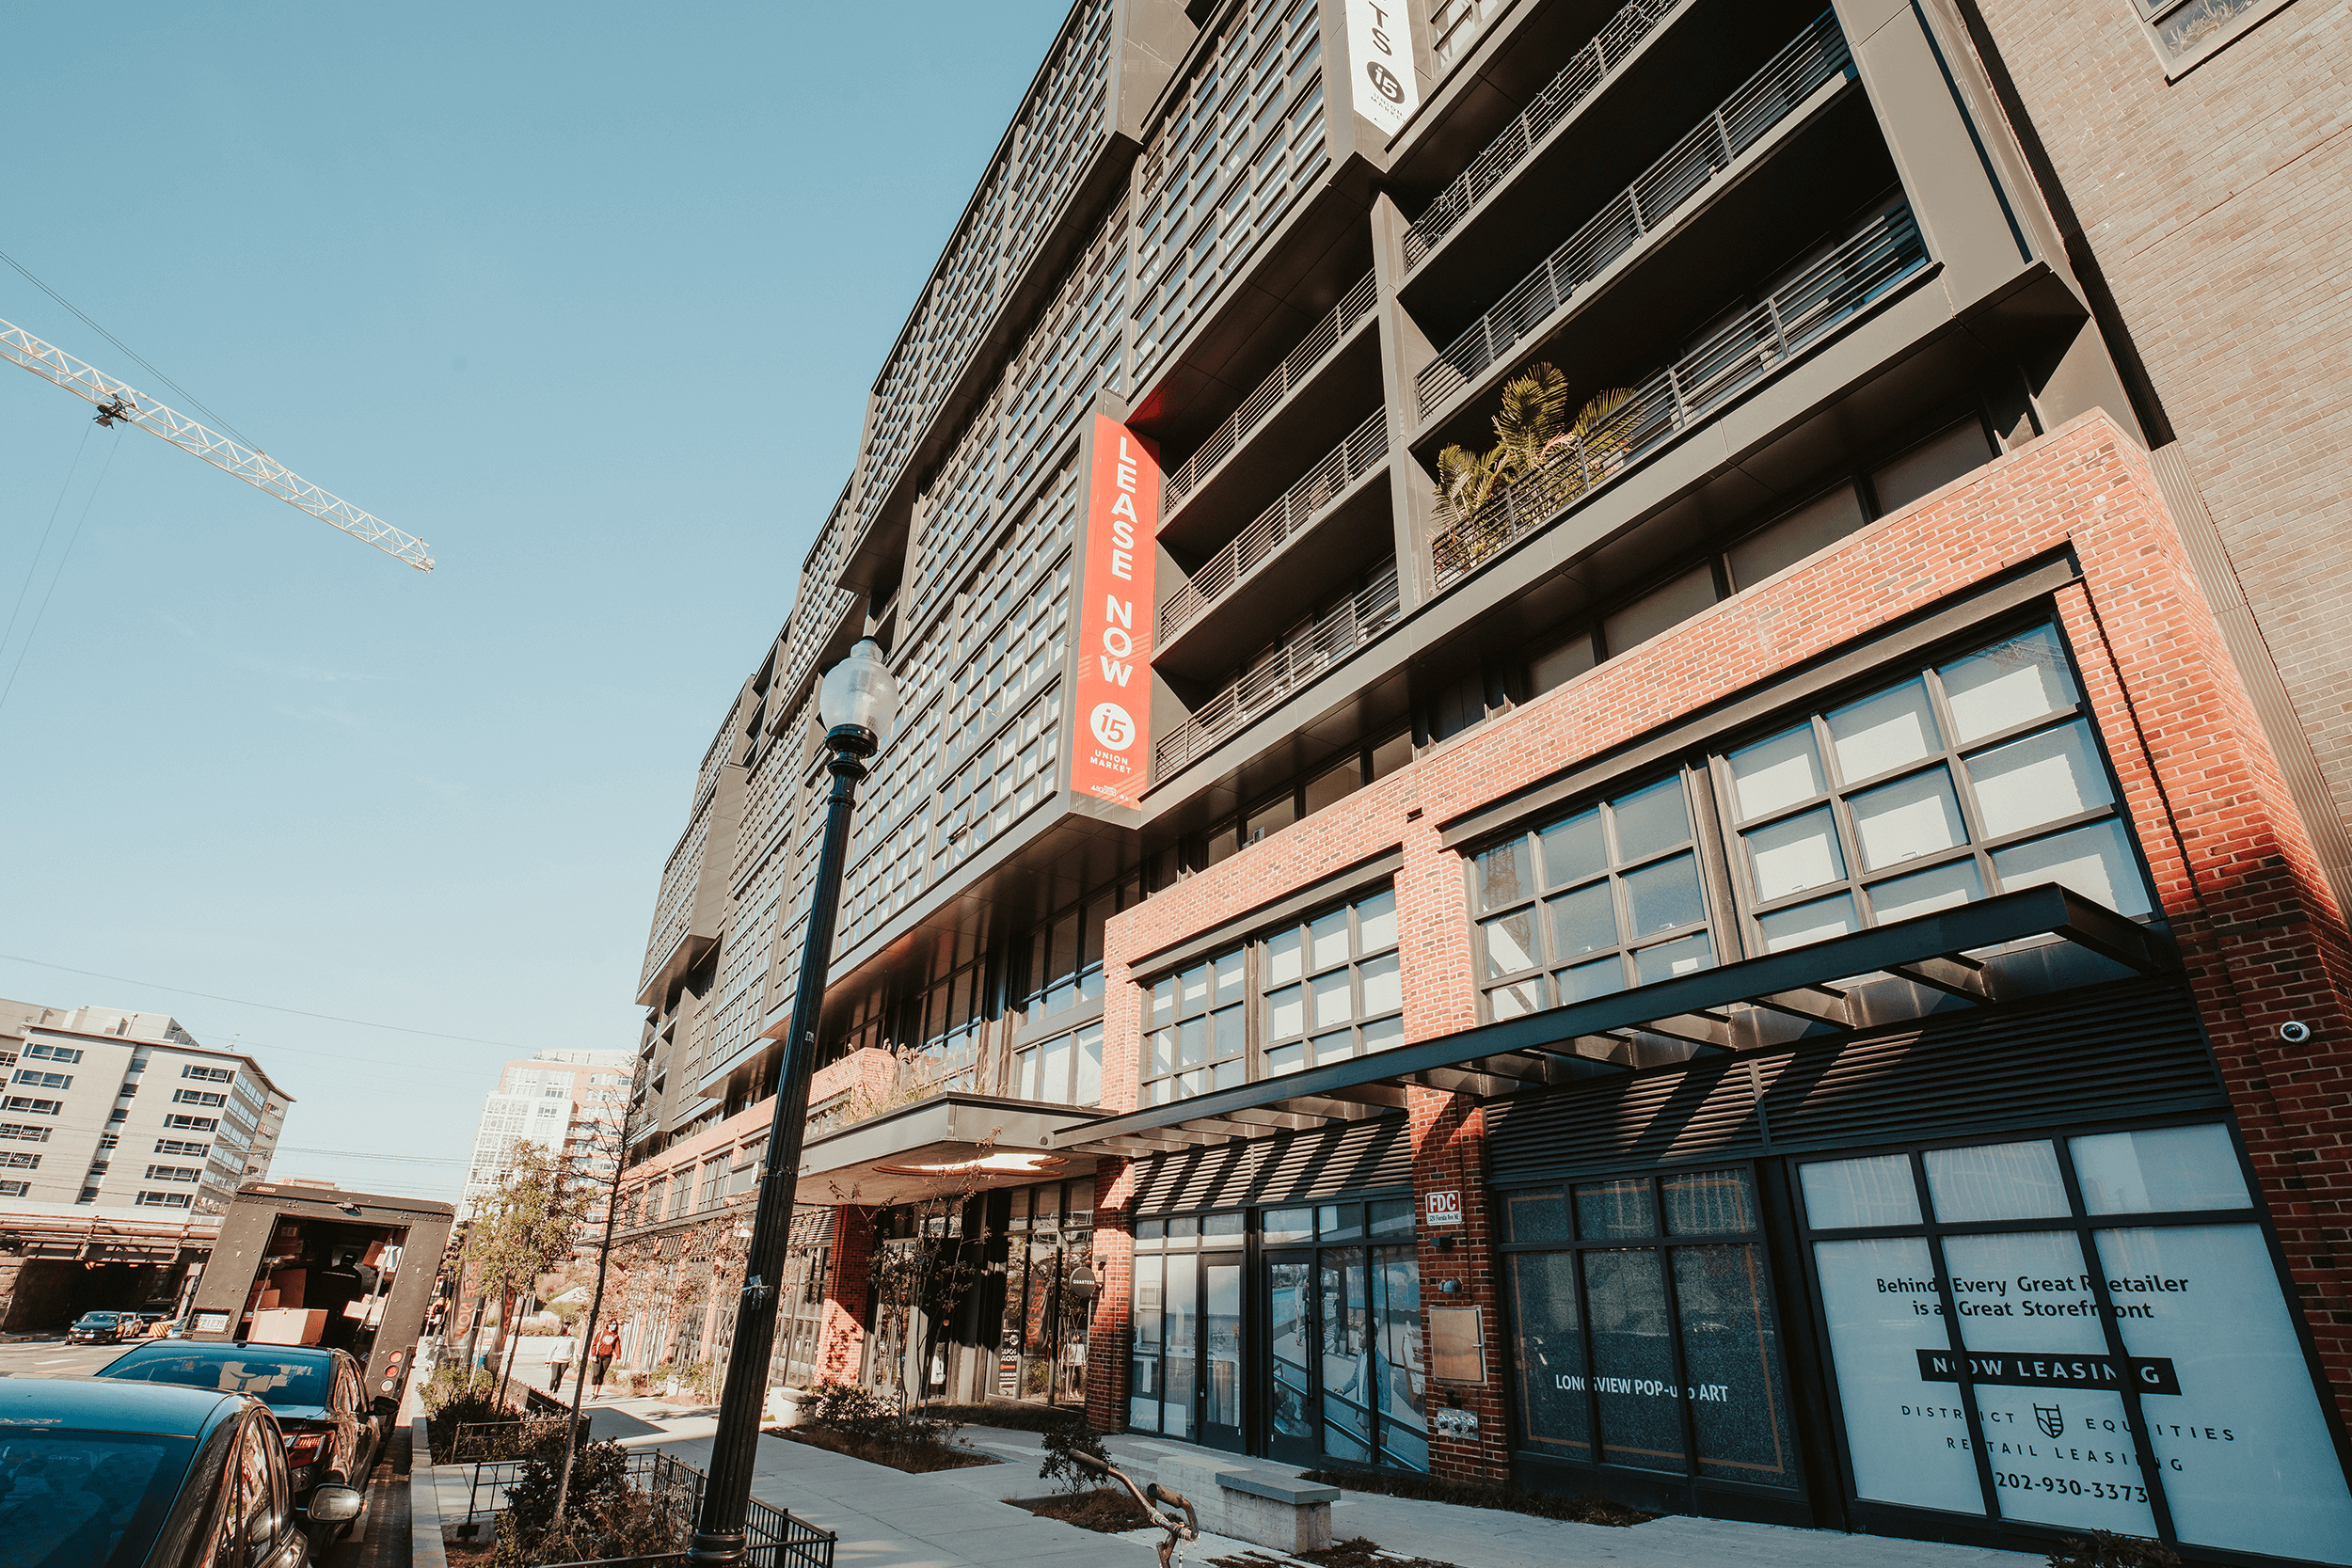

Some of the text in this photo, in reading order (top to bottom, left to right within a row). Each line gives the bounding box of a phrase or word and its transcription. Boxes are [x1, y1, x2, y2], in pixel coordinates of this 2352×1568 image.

[1368, 0, 1392, 56] TS
[1375, 66, 1398, 99] i5
[1099, 436, 1138, 688] LEASE NOW
[1101, 708, 1126, 743] i5
[1089, 755, 1133, 775] MARKET
[1094, 749, 1129, 767] UNION
[1430, 1194, 1456, 1212] FDC
[1876, 1275, 2189, 1296] Behind Every Great Retailer
[1913, 1300, 2154, 1319] is a Great Storefront
[2016, 1360, 2160, 1384] LEASING
[1699, 1384, 1728, 1402] ART
[1901, 1405, 2014, 1424] DISTRICT
[1947, 1437, 2038, 1457] RETAIL
[1994, 1471, 2149, 1503] 202-930-3373
